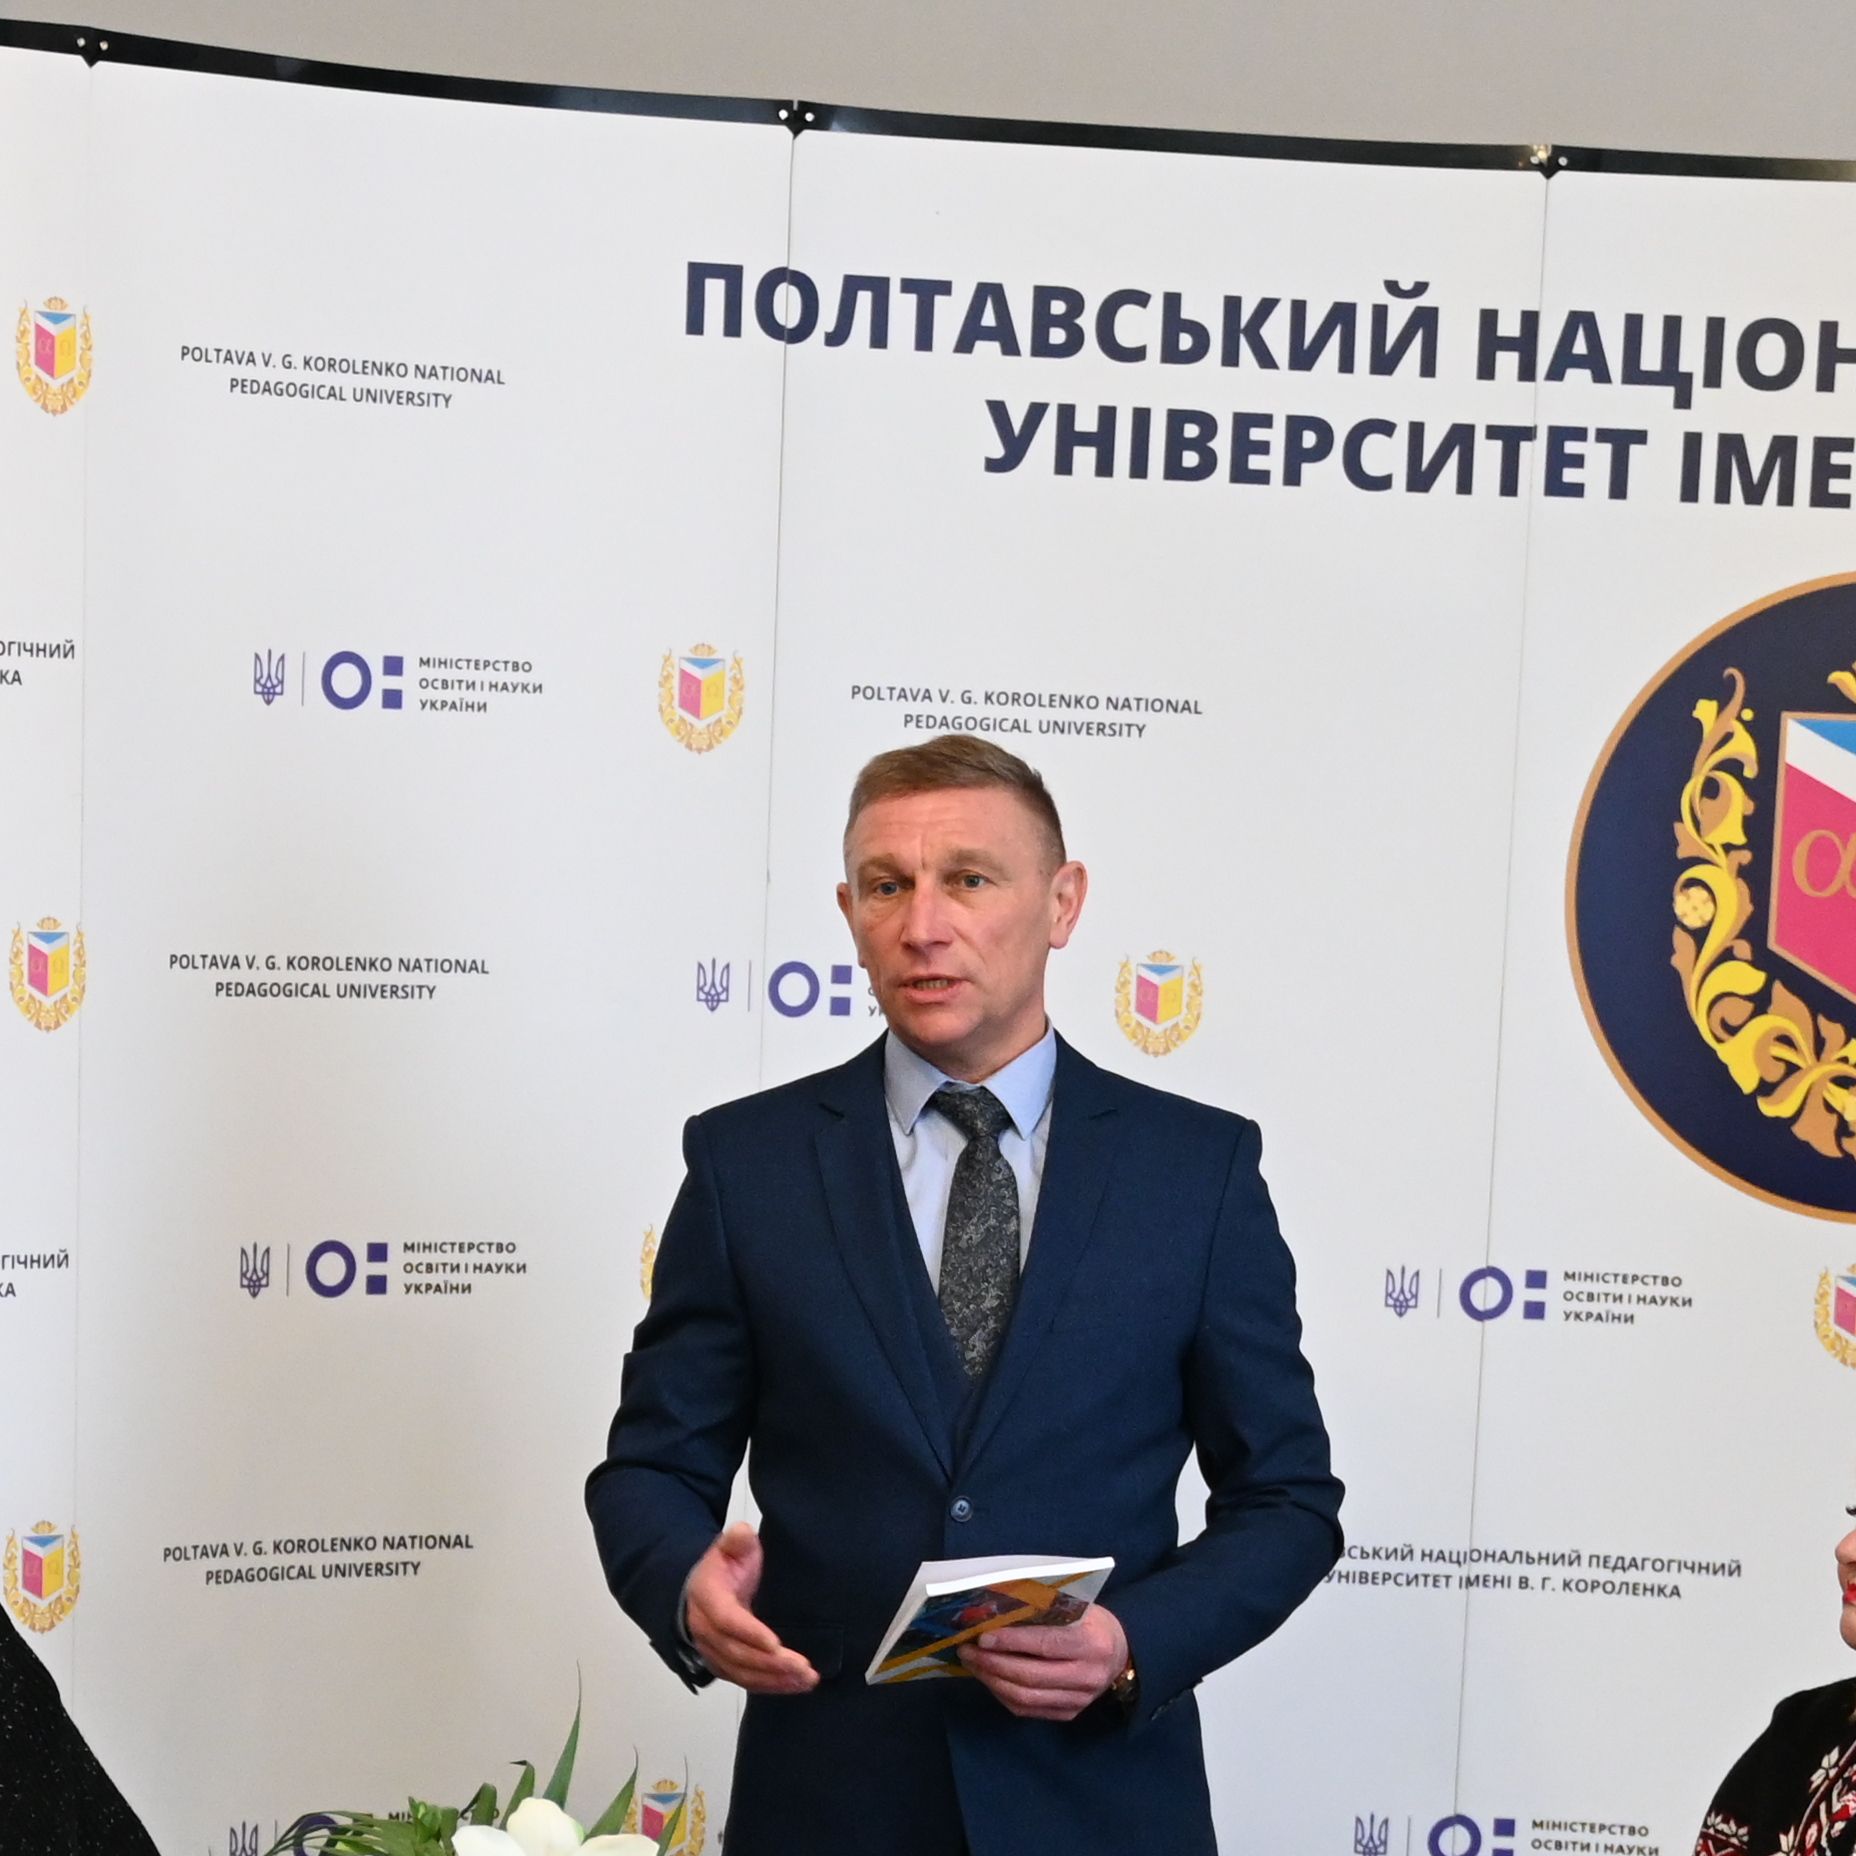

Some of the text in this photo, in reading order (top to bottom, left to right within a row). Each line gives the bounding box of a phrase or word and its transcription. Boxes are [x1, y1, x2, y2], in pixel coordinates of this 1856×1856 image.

[684, 260, 1440, 379] ПОЛТАВСЬКИЙ
[180, 344, 506, 386] POLTAVA V. G. KOROLENKO NATIONAL
[229, 377, 453, 409] PEDAGOGICAL UNIVERSITY
[983, 399, 1649, 502] УНІВЕРСИТЕТ
[418, 656, 533, 674] МІНІСТЕРСТВО
[418, 677, 477, 692] ОСВІТИ
[488, 680, 543, 695] НАУКИ
[419, 697, 488, 713] УКРАЇНИ
[851, 684, 1203, 716] POLTAVA V. G. KOROLENKO NATIONAL
[903, 713, 1147, 739] PEDAGOGICAL UNIVERSITY
[169, 953, 490, 975] POLTAVA V. G. KOROLENKO NATIONAL
[215, 981, 437, 1000] PEDAGOGICAL UNIVERSITY
[402, 1241, 517, 1254] МІНІСТЕРСТВО
[402, 1261, 461, 1275] ОСВІТИ
[472, 1262, 527, 1275] НАУКИ
[403, 1279, 472, 1295] УКРАЇНИ
[1563, 1270, 1683, 1288] МІНІСТЕРСТВО
[1562, 1290, 1624, 1304] ОСВІТИ
[1636, 1294, 1693, 1308] НАУКИ
[1562, 1309, 1635, 1325] УКРАЇНИ
[163, 1533, 474, 1563] POLTAVA V. G. KOROLENKO NATIONAL
[205, 1560, 422, 1586] PEDAGOGICAL UNIVERSITY
[1420, 1548, 1582, 1569] НАЦІОНАЛЬНИЙ
[1587, 1554, 1742, 1578] ПЕДАГОГІЧНИЙ
[1458, 1573, 1512, 1591] ІМЕНІ
[1518, 1575, 1535, 1591] В.
[1540, 1576, 1556, 1592] Г.
[1562, 1577, 1682, 1599] КОРОЛЕНКА
[1531, 1818, 1650, 1838] МІНІСТЕРСТВО
[1530, 1837, 1592, 1853] ОСВІТИ
